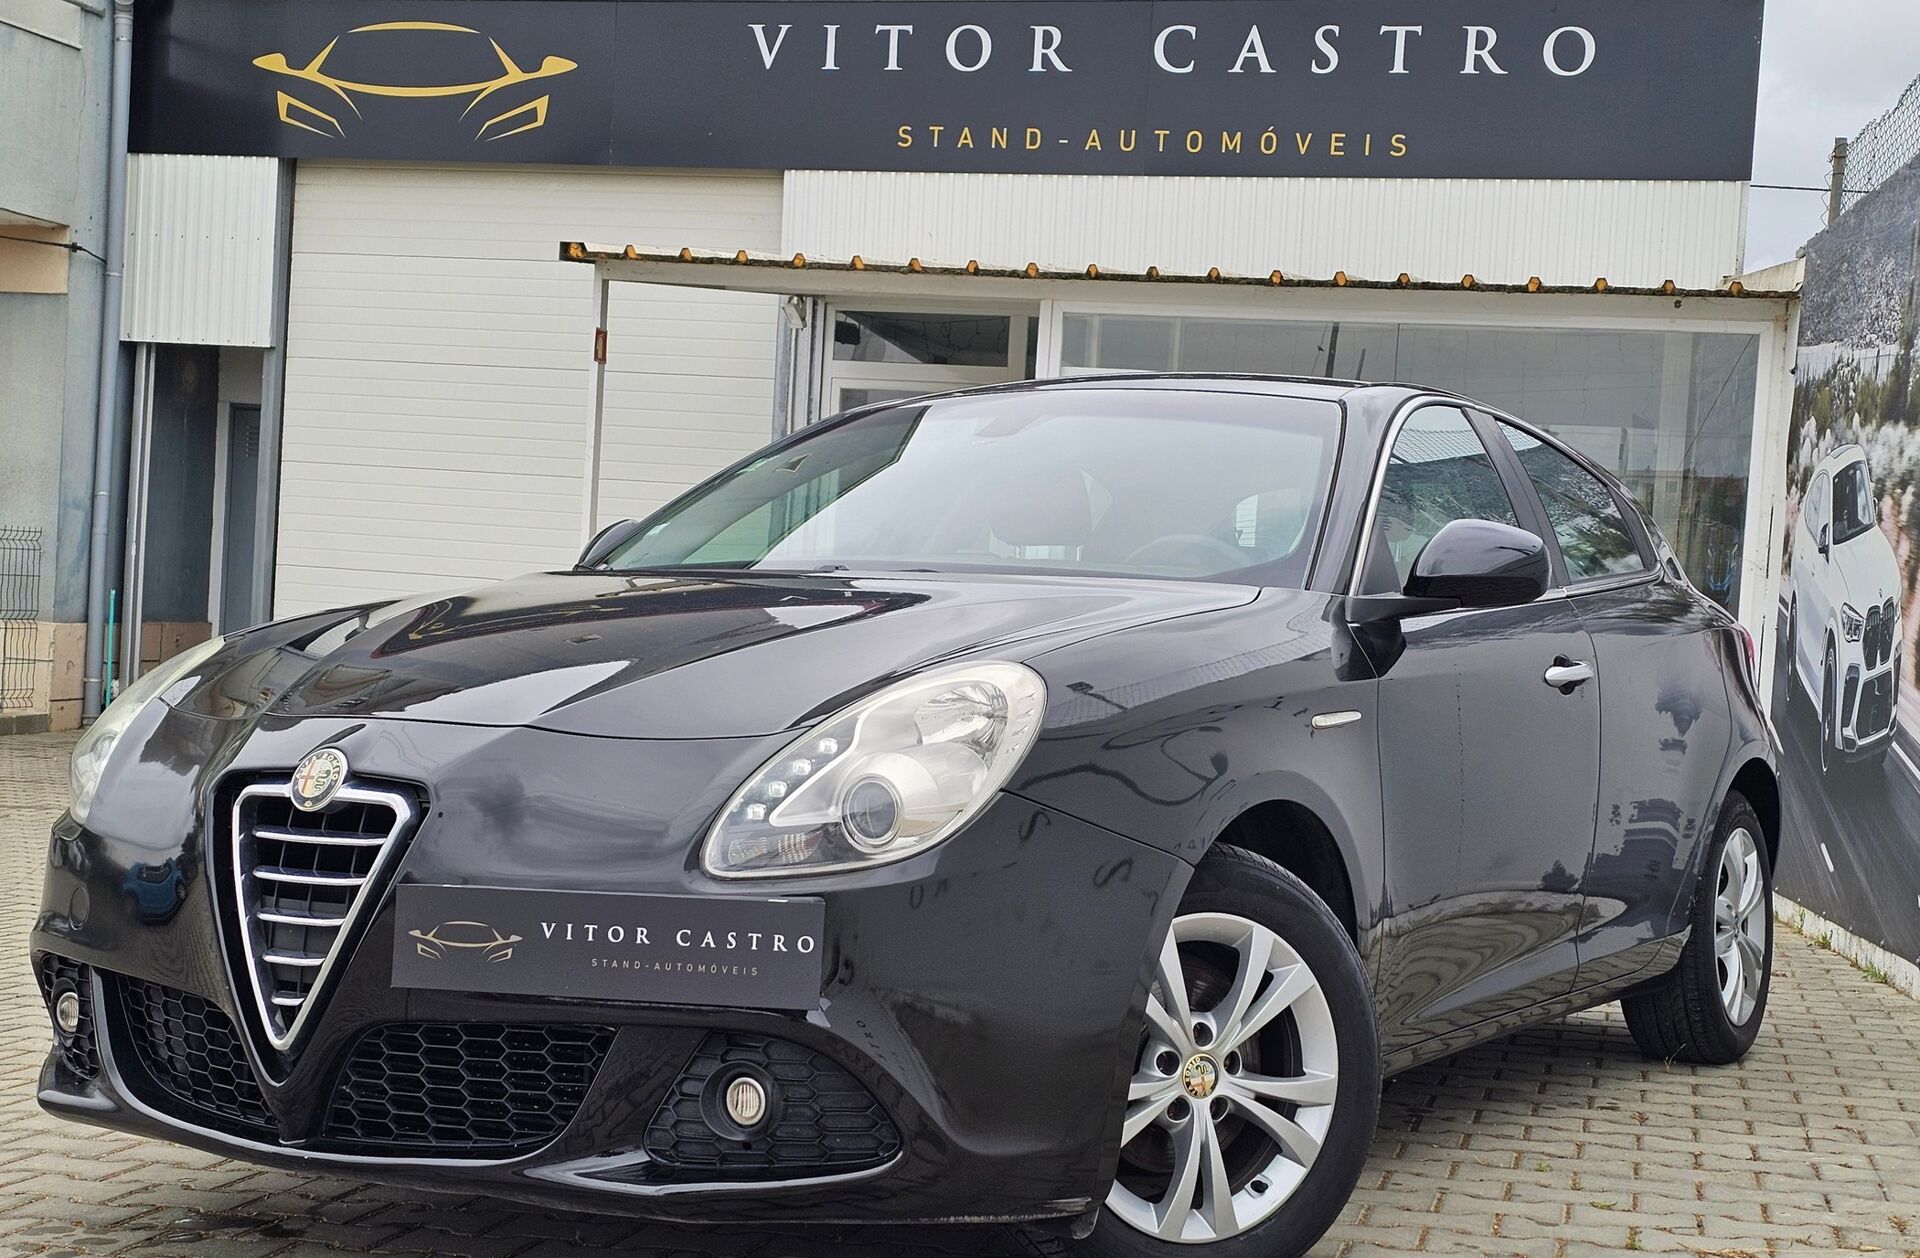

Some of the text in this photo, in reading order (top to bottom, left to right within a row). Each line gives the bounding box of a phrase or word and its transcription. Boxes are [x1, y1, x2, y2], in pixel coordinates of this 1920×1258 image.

[747, 23, 1597, 76] VITOR CASTRO
[897, 124, 1408, 157] STAND-AUTOMÓVEIS
[540, 921, 816, 954] VITOR CASTRO
[591, 957, 759, 976] STAND-AUTOMÓVEIS
